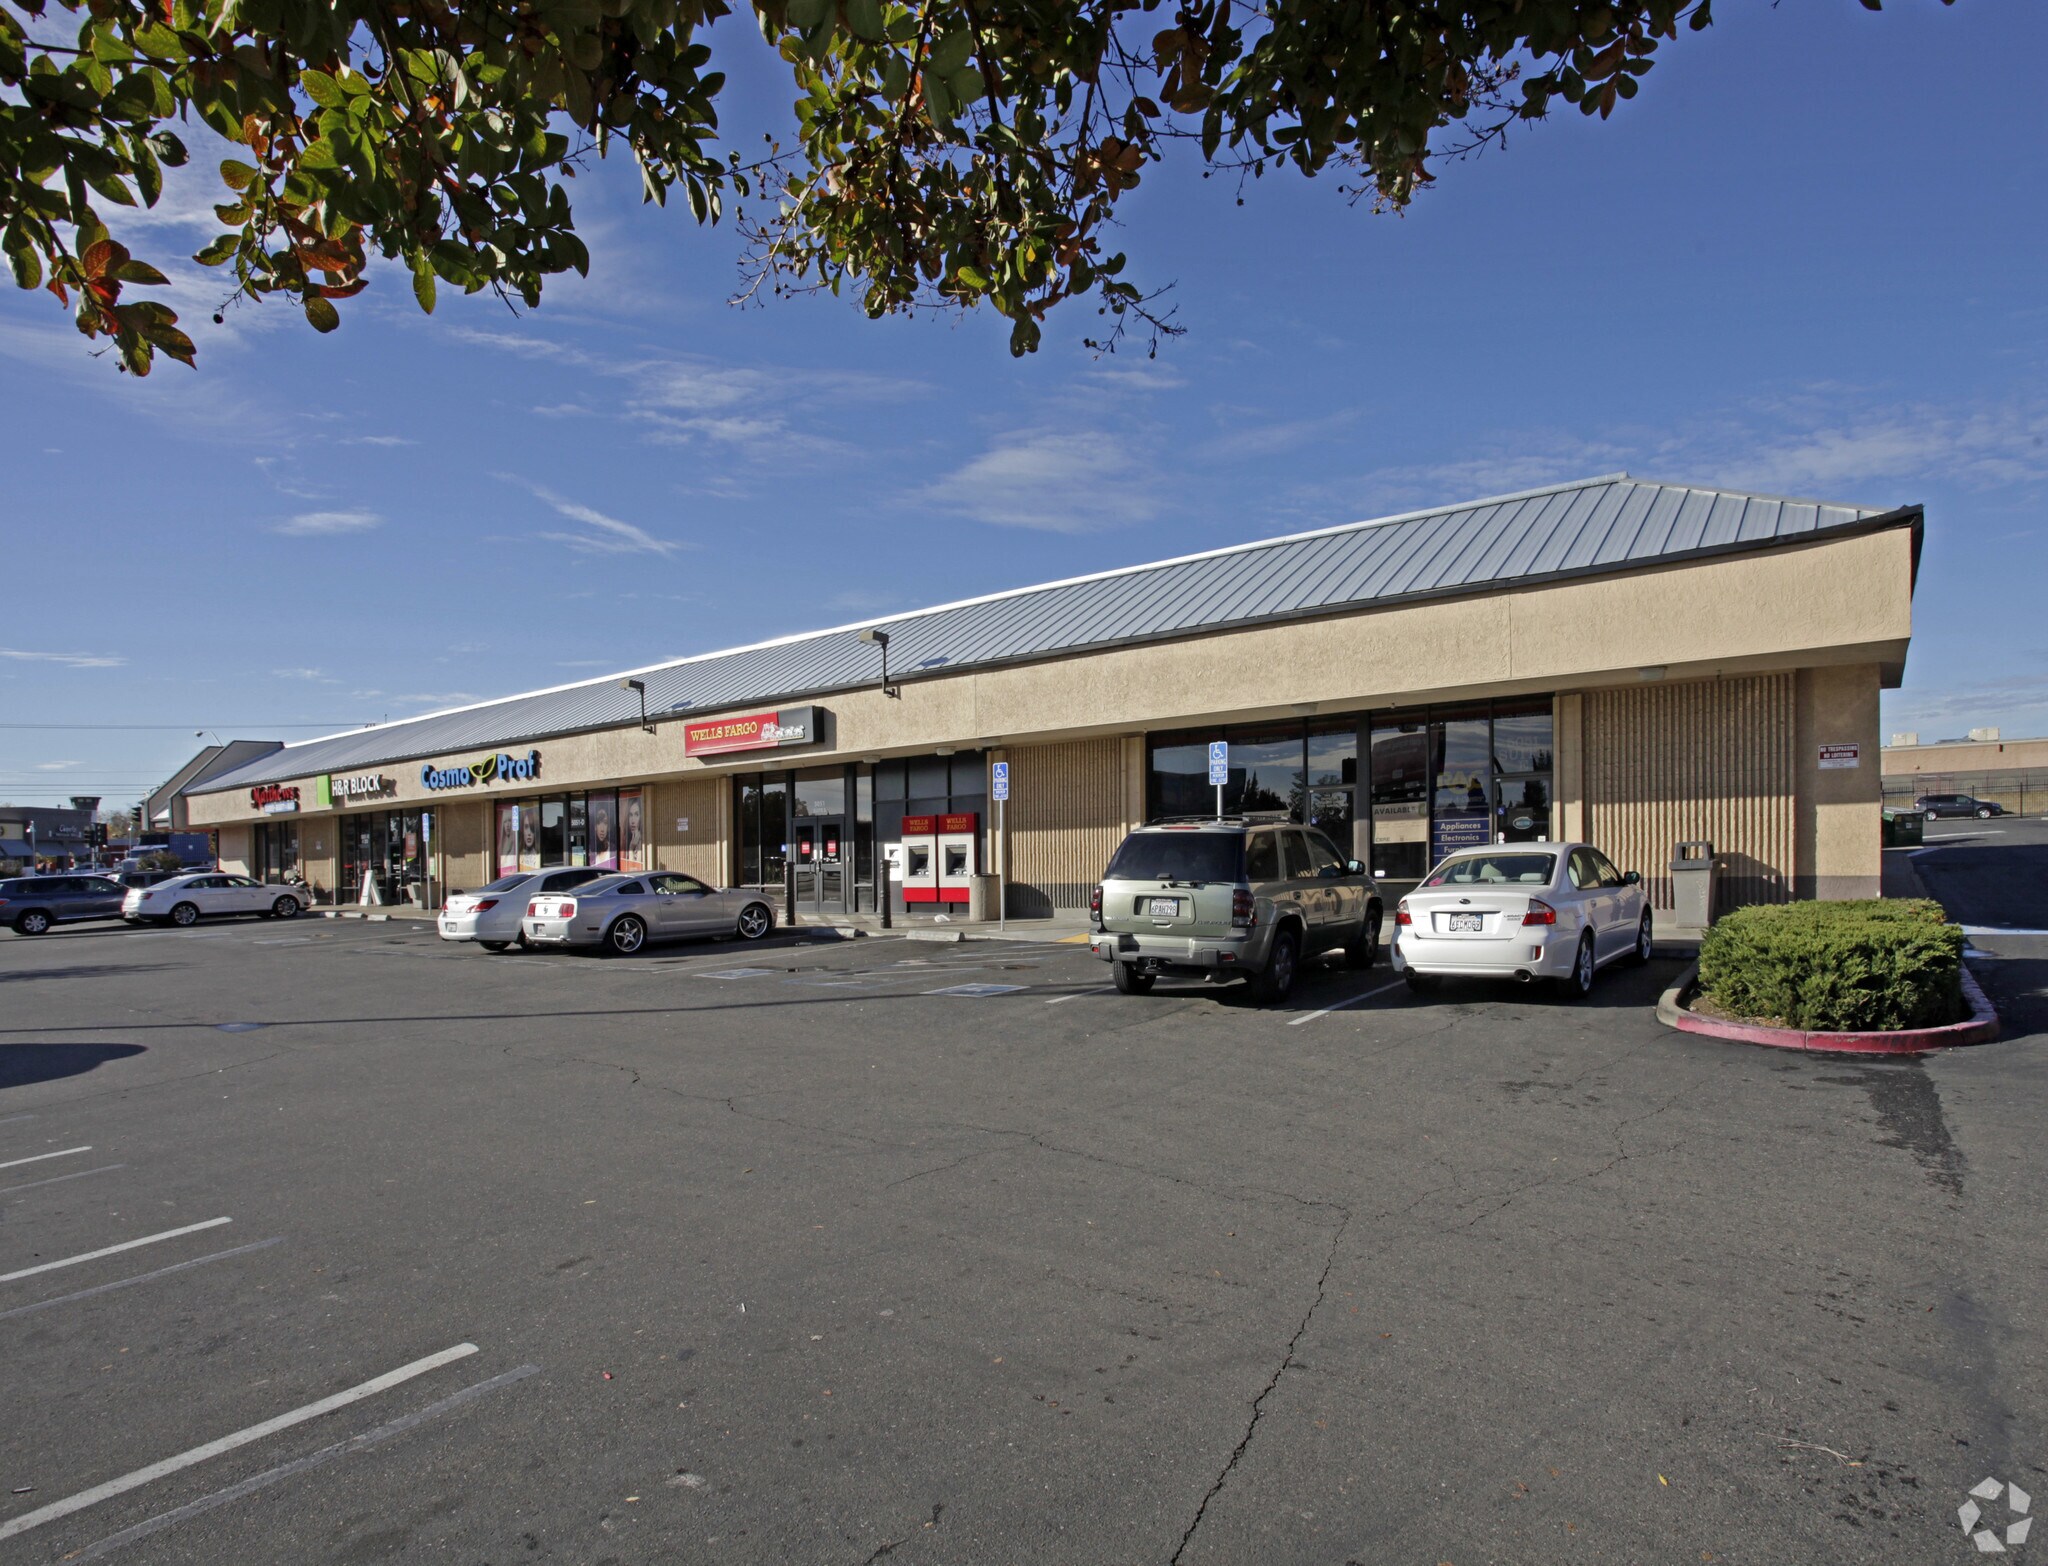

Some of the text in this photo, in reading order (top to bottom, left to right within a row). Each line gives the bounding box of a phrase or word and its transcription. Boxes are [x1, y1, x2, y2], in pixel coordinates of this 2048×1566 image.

[690, 721, 758, 741] WELLS FARGO
[420, 749, 534, 789] Cosmo Prof
[332, 774, 380, 797] H&R BLOCK
[946, 823, 967, 831] FARGO
[1440, 822, 1481, 831] Appliances
[1441, 834, 1480, 842] Electronics
